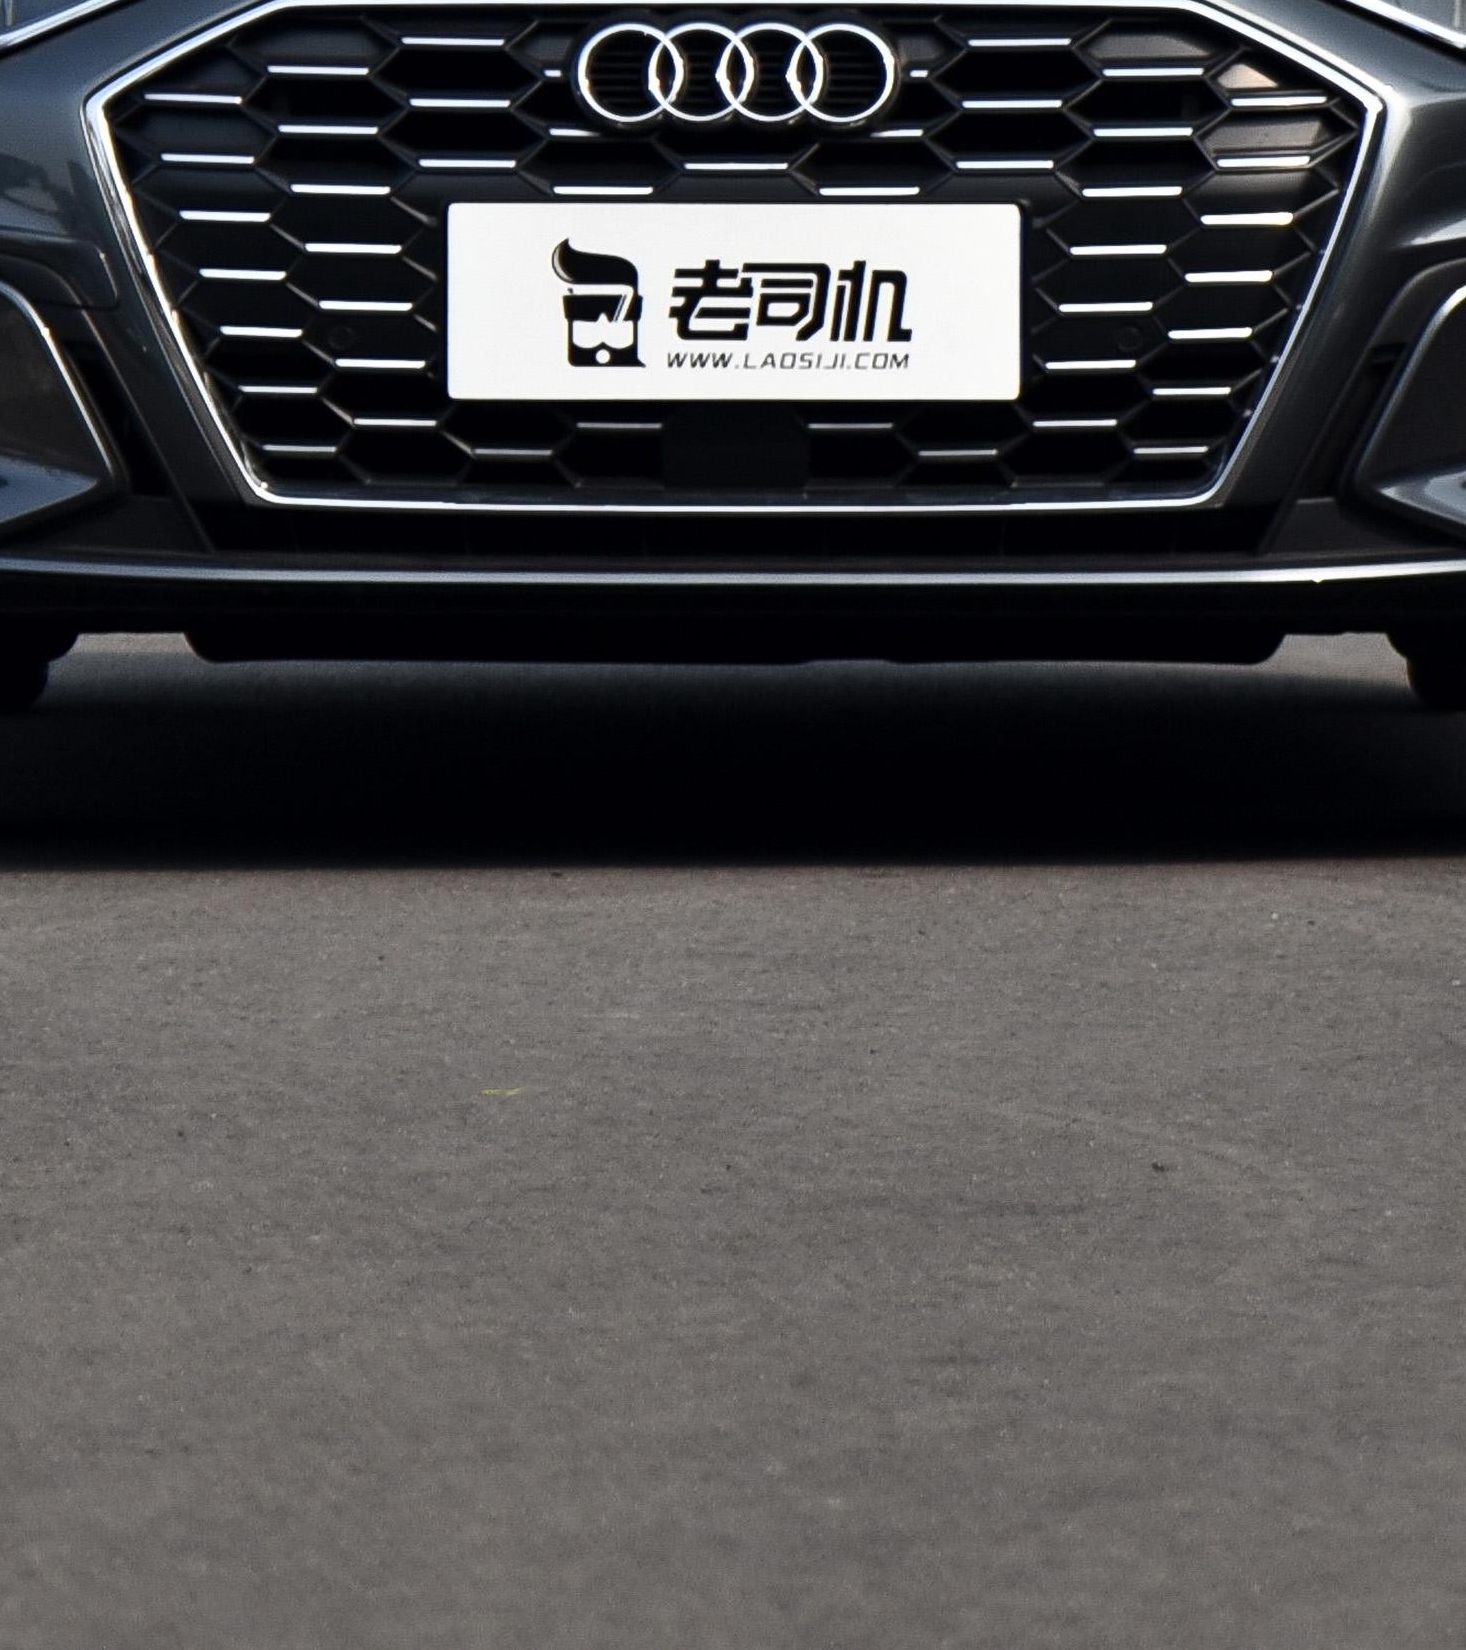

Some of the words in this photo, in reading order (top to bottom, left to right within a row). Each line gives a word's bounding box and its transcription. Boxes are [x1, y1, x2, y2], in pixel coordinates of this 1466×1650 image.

[669, 259, 912, 342] 老司机
[667, 352, 910, 370] WWW.LAOSIJI.COM
